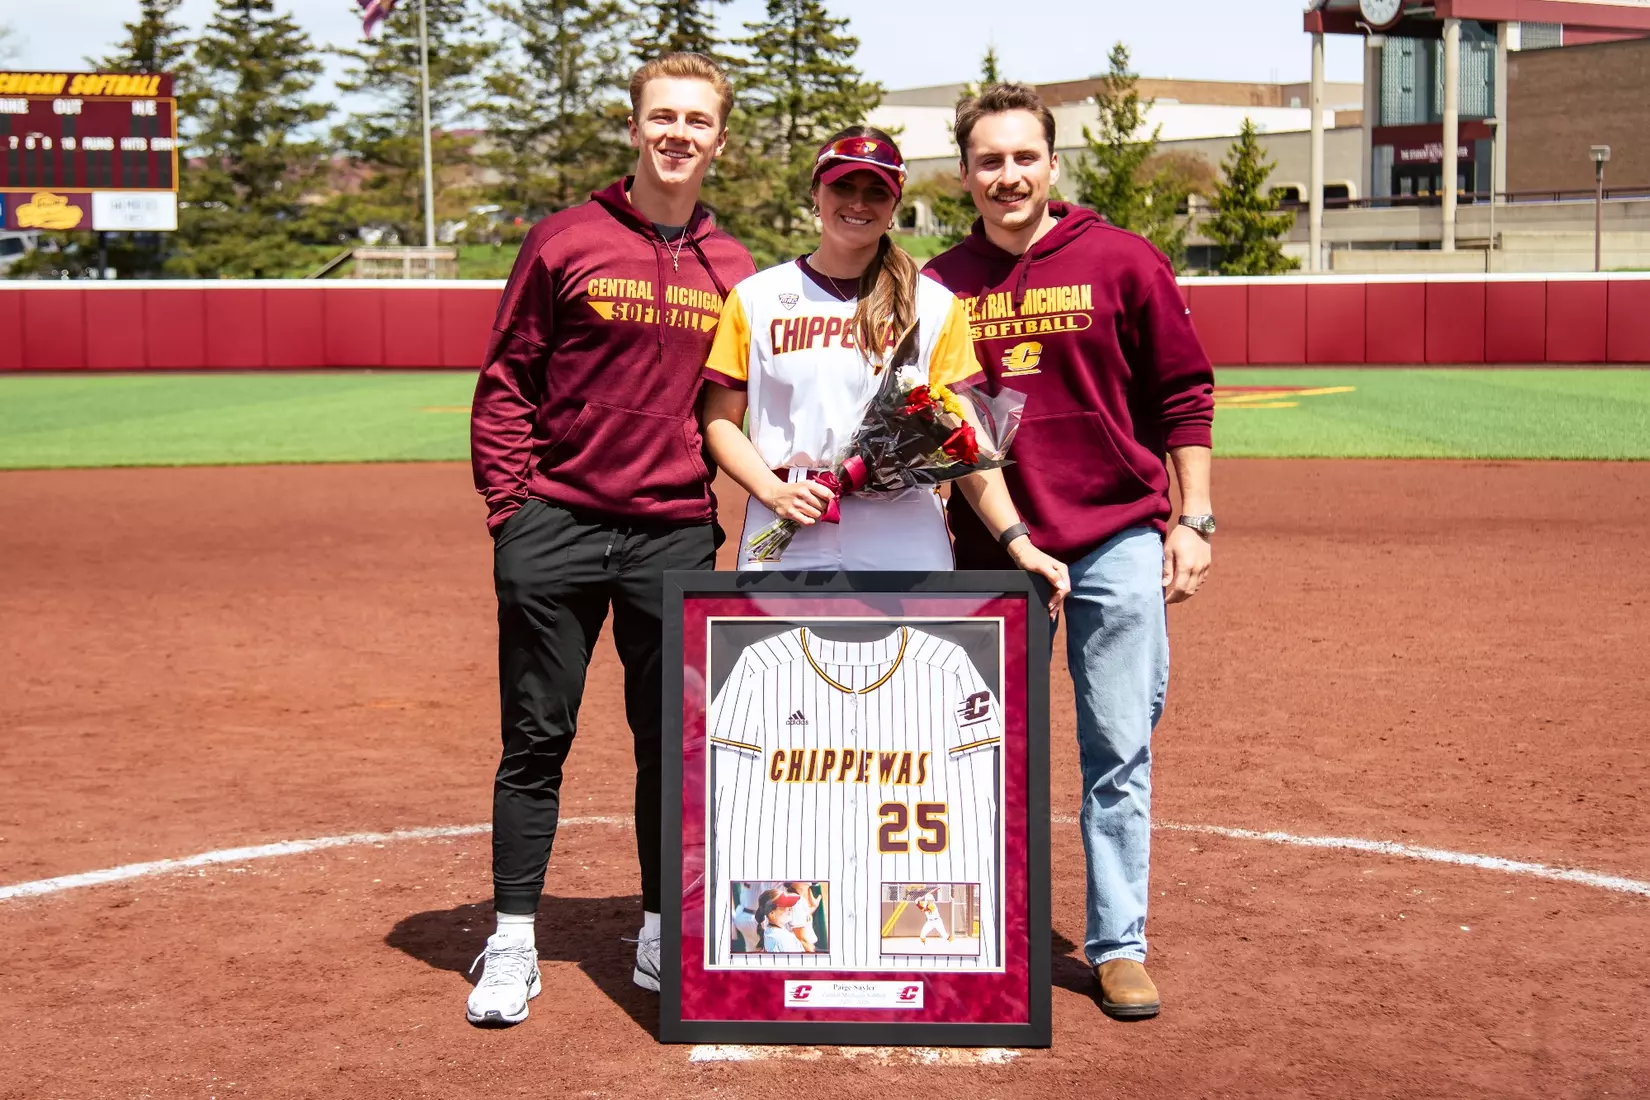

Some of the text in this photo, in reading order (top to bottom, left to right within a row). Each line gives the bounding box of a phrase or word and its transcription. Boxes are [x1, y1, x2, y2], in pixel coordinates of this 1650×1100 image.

[68, 74, 161, 96] SOFTBALL
[53, 98, 83, 115] OUT
[120, 137, 147, 151] HITS
[587, 278, 654, 300] CENTRAL
[1020, 284, 1092, 316] MICHIGAN
[969, 316, 1078, 340] SOFTBALL
[785, 718, 809, 726] adidas
[769, 747, 932, 787] CHIPPEWAS
[876, 801, 950, 855] 25
